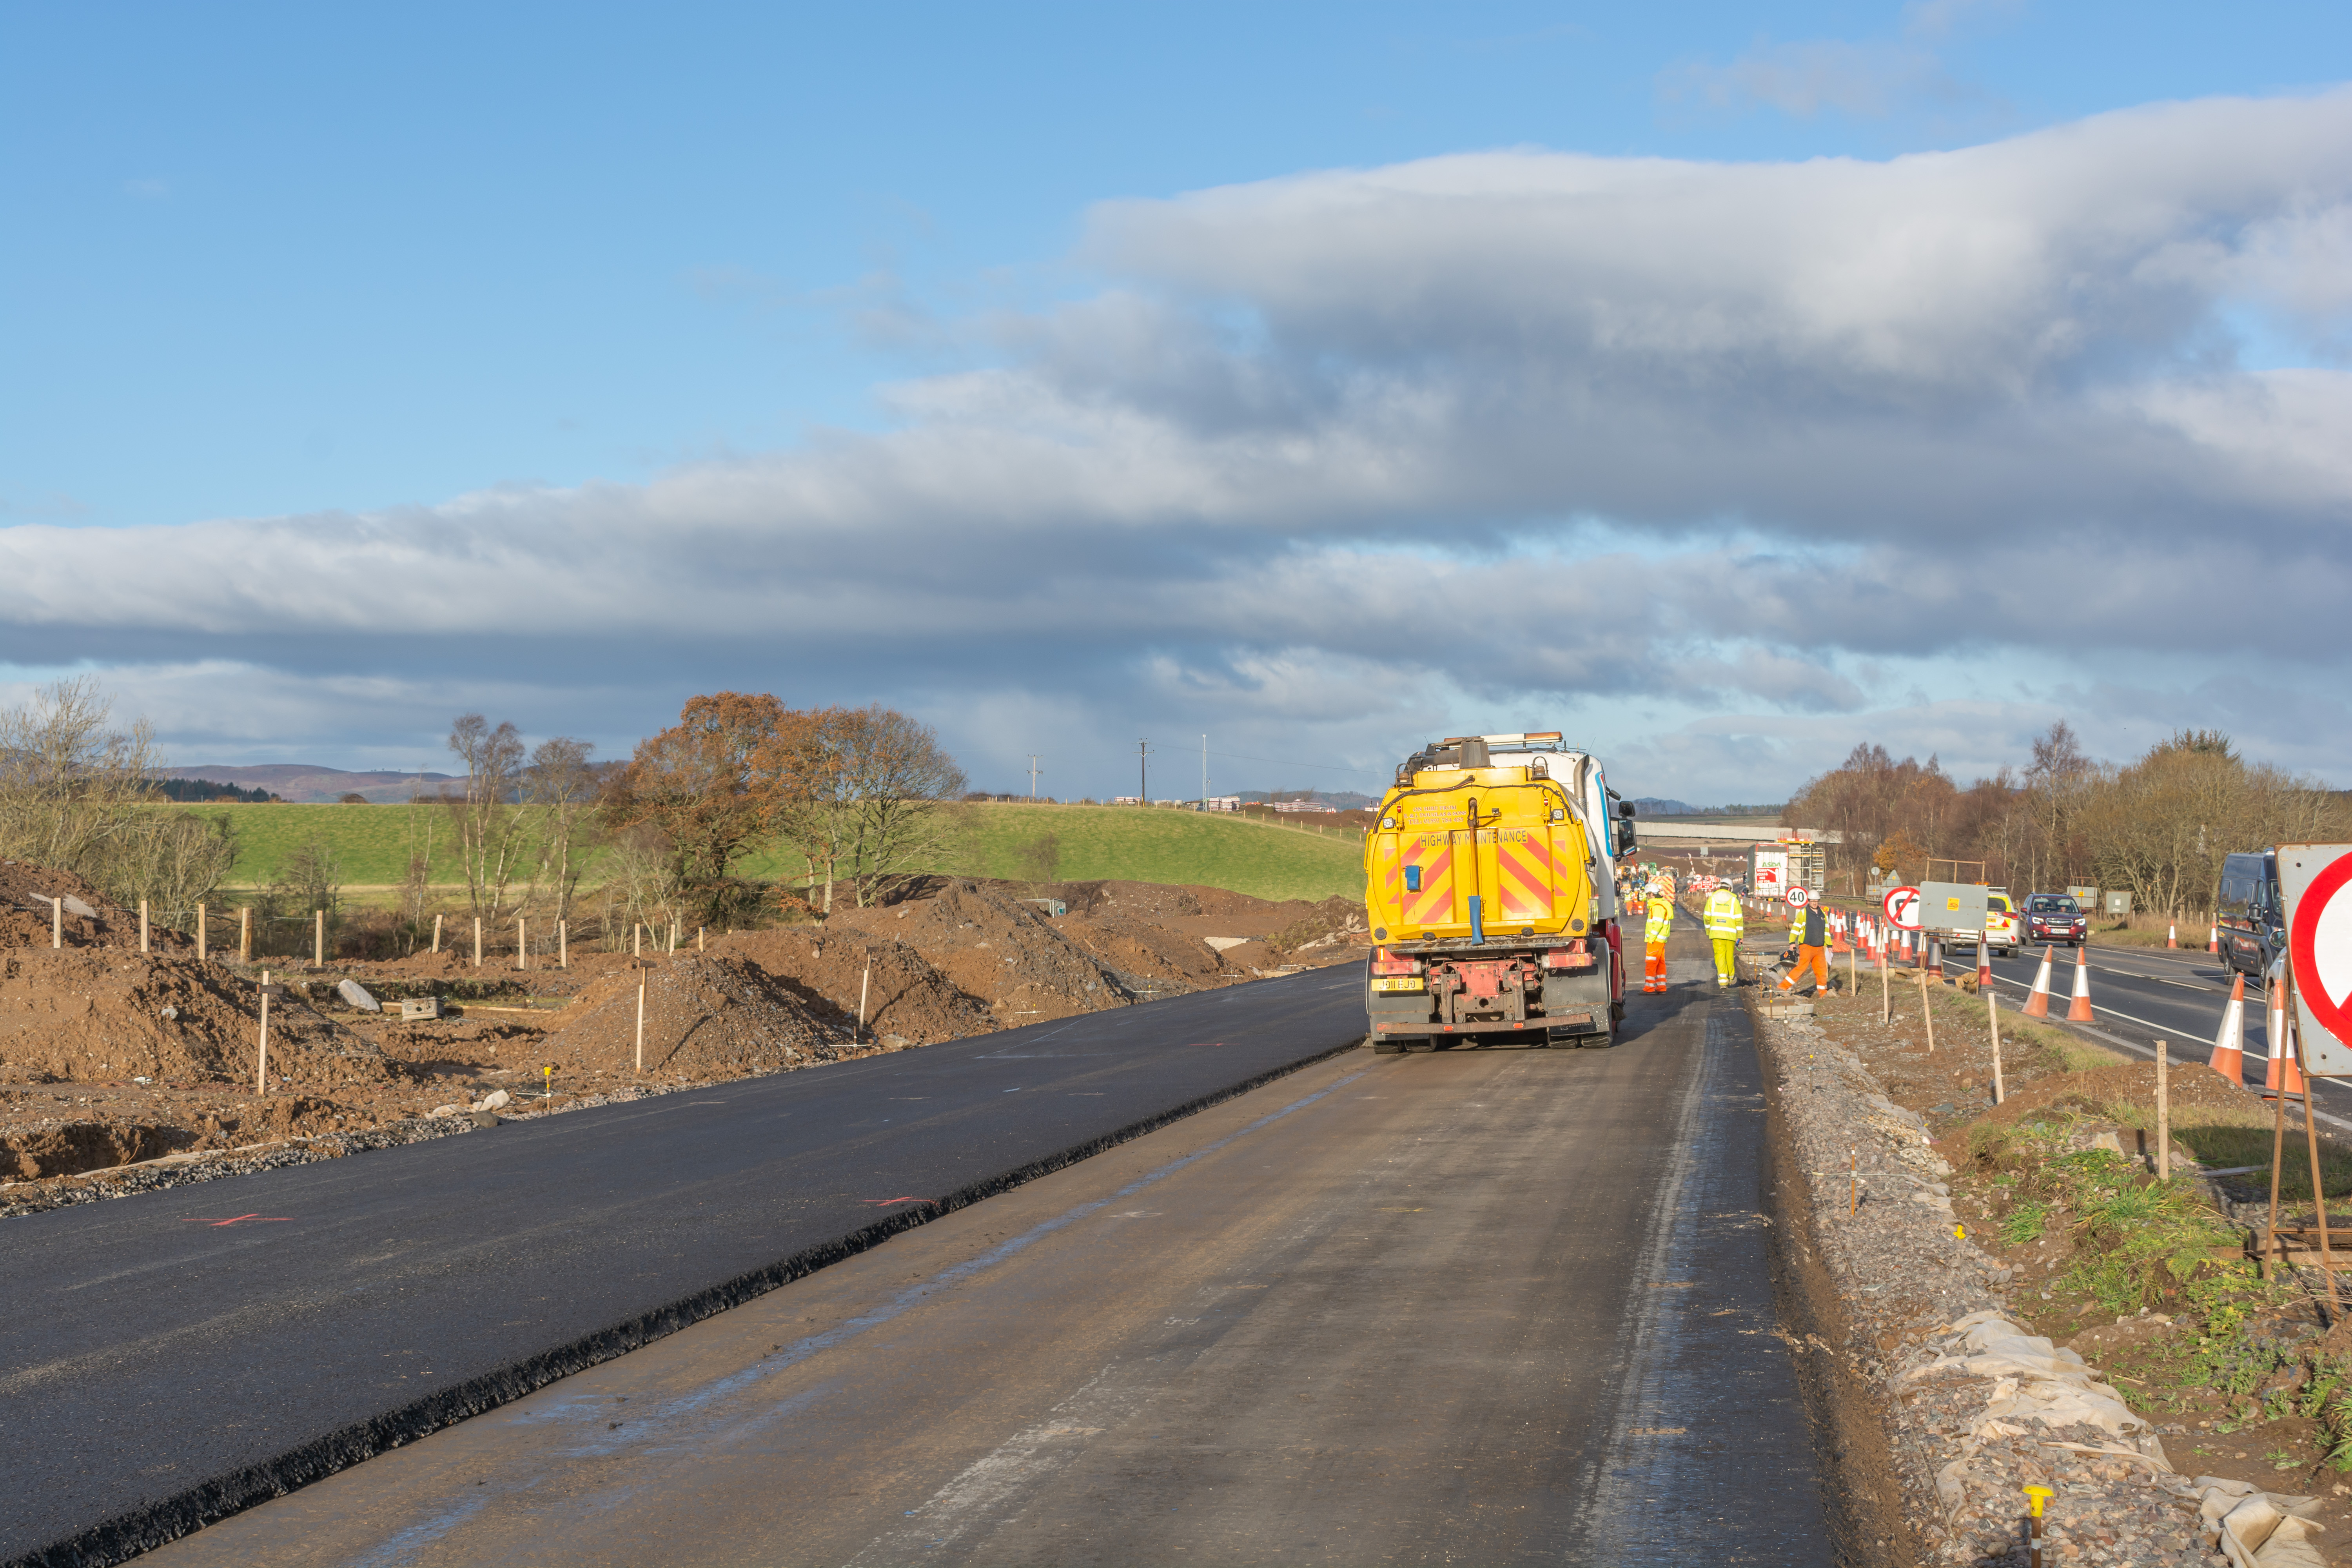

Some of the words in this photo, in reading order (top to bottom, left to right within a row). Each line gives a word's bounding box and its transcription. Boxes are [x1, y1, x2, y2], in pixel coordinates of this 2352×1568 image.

[1421, 833, 1462, 847] HIGHWAY
[1465, 830, 1527, 845] MAINTENANCE
[1790, 891, 1804, 902] 40
[2159, 1045, 2165, 1056] CH
